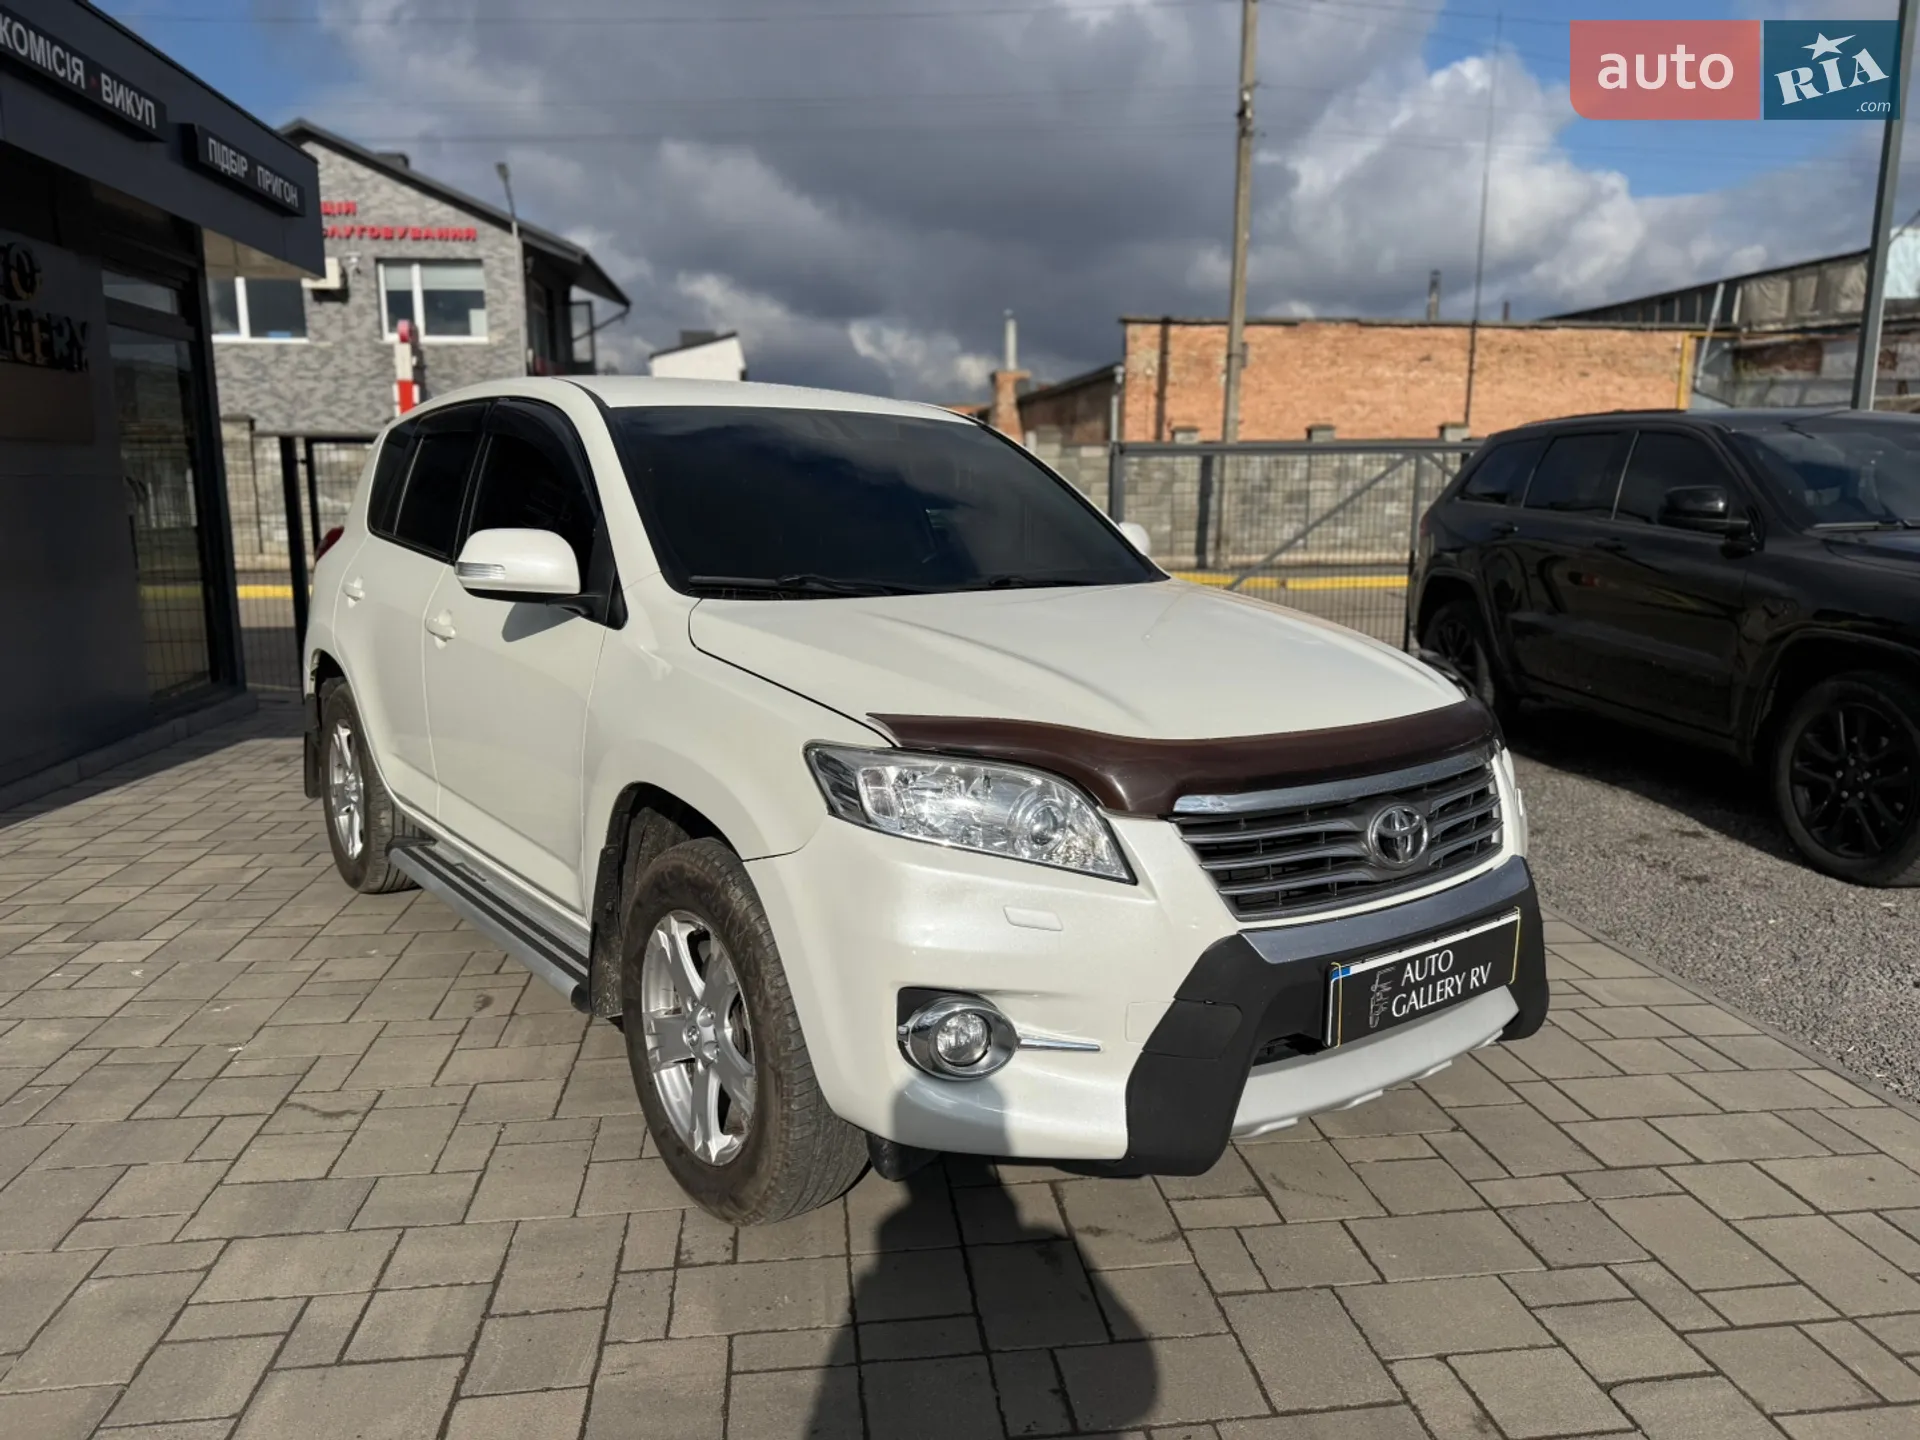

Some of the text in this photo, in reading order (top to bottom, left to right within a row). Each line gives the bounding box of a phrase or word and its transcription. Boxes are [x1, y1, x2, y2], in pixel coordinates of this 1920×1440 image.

[0, 12, 156, 129] КОМІСІЯ ВИКУП
[208, 137, 299, 208] ПІДБІР ПРИГОН
[1391, 962, 1492, 1018] GALLERY RV
[1401, 950, 1454, 986] AUTO
